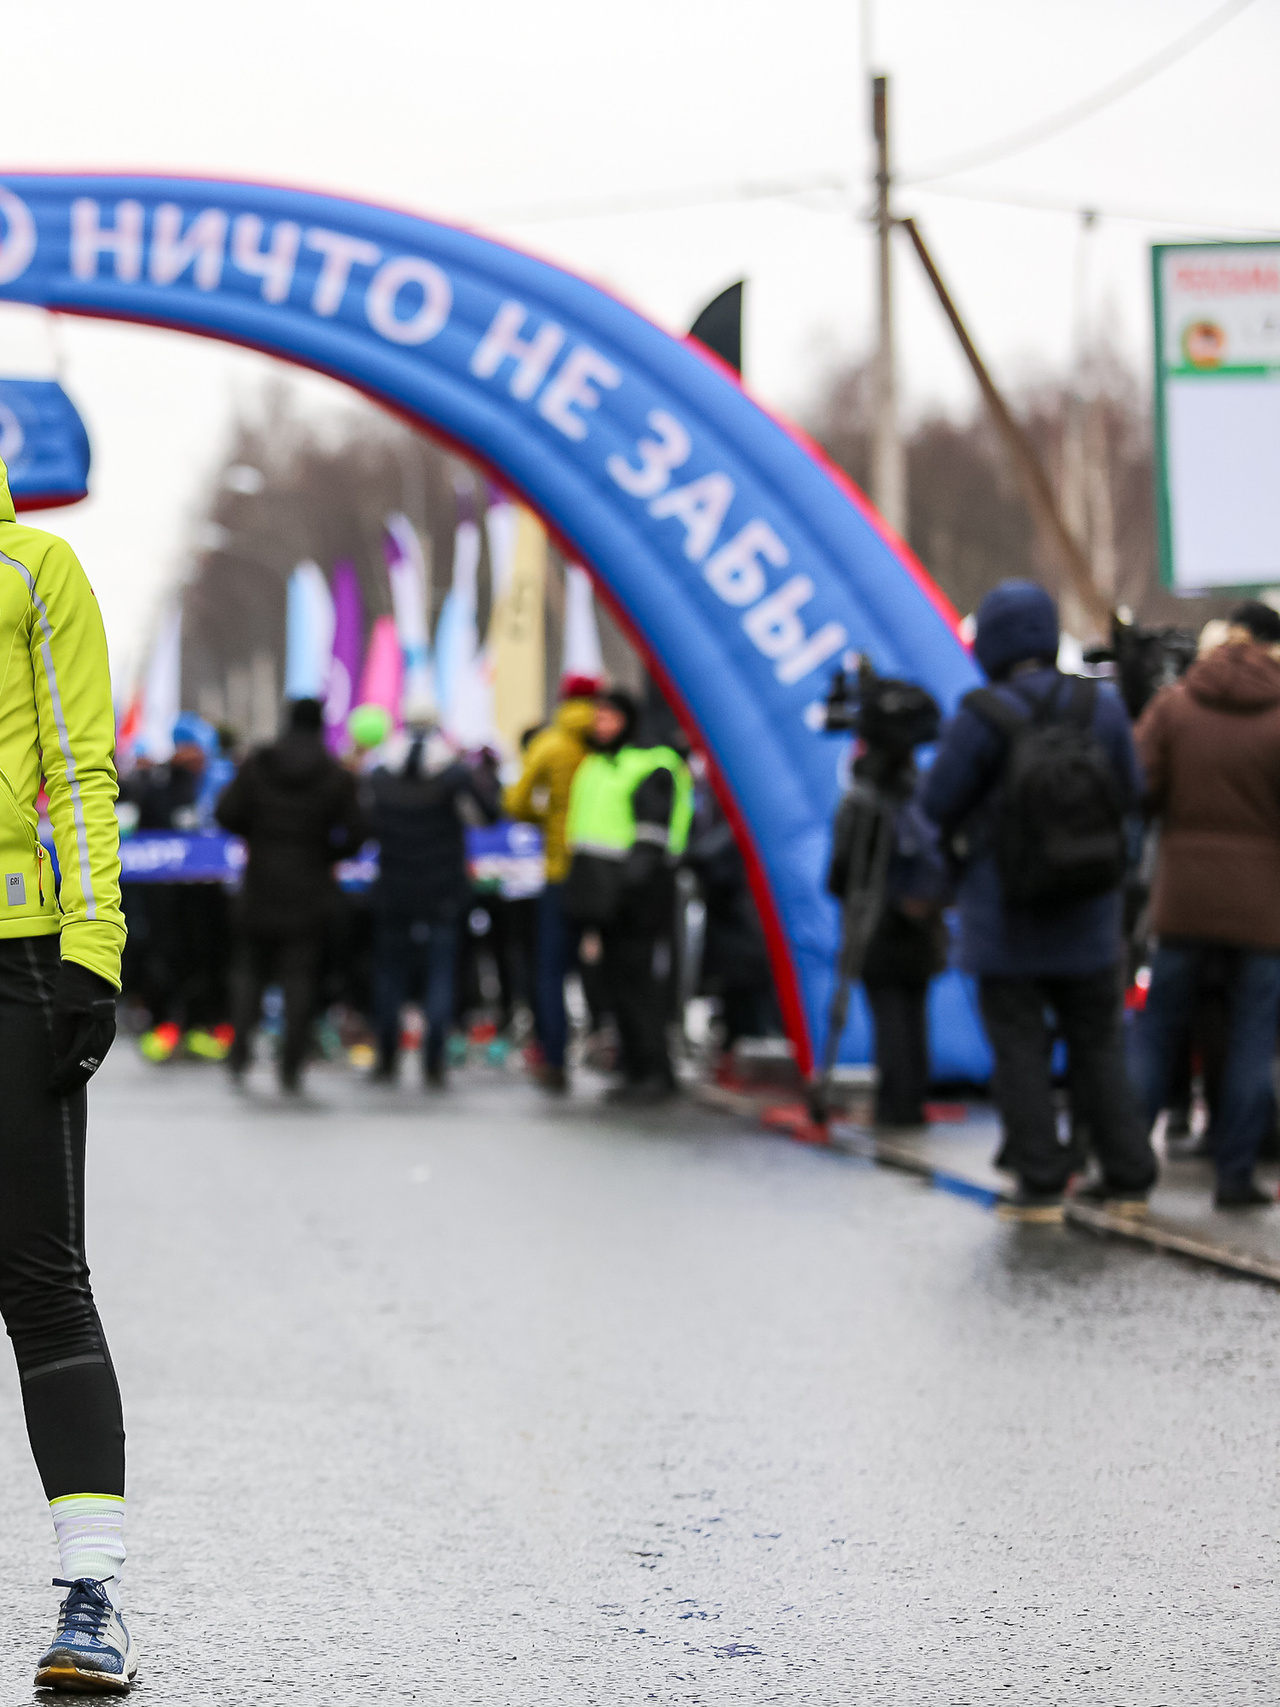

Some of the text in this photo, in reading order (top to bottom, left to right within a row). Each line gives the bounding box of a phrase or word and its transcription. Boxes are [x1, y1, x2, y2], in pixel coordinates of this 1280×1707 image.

[69, 197, 856, 700] НИЧТО НЕ ЗАБЫ
